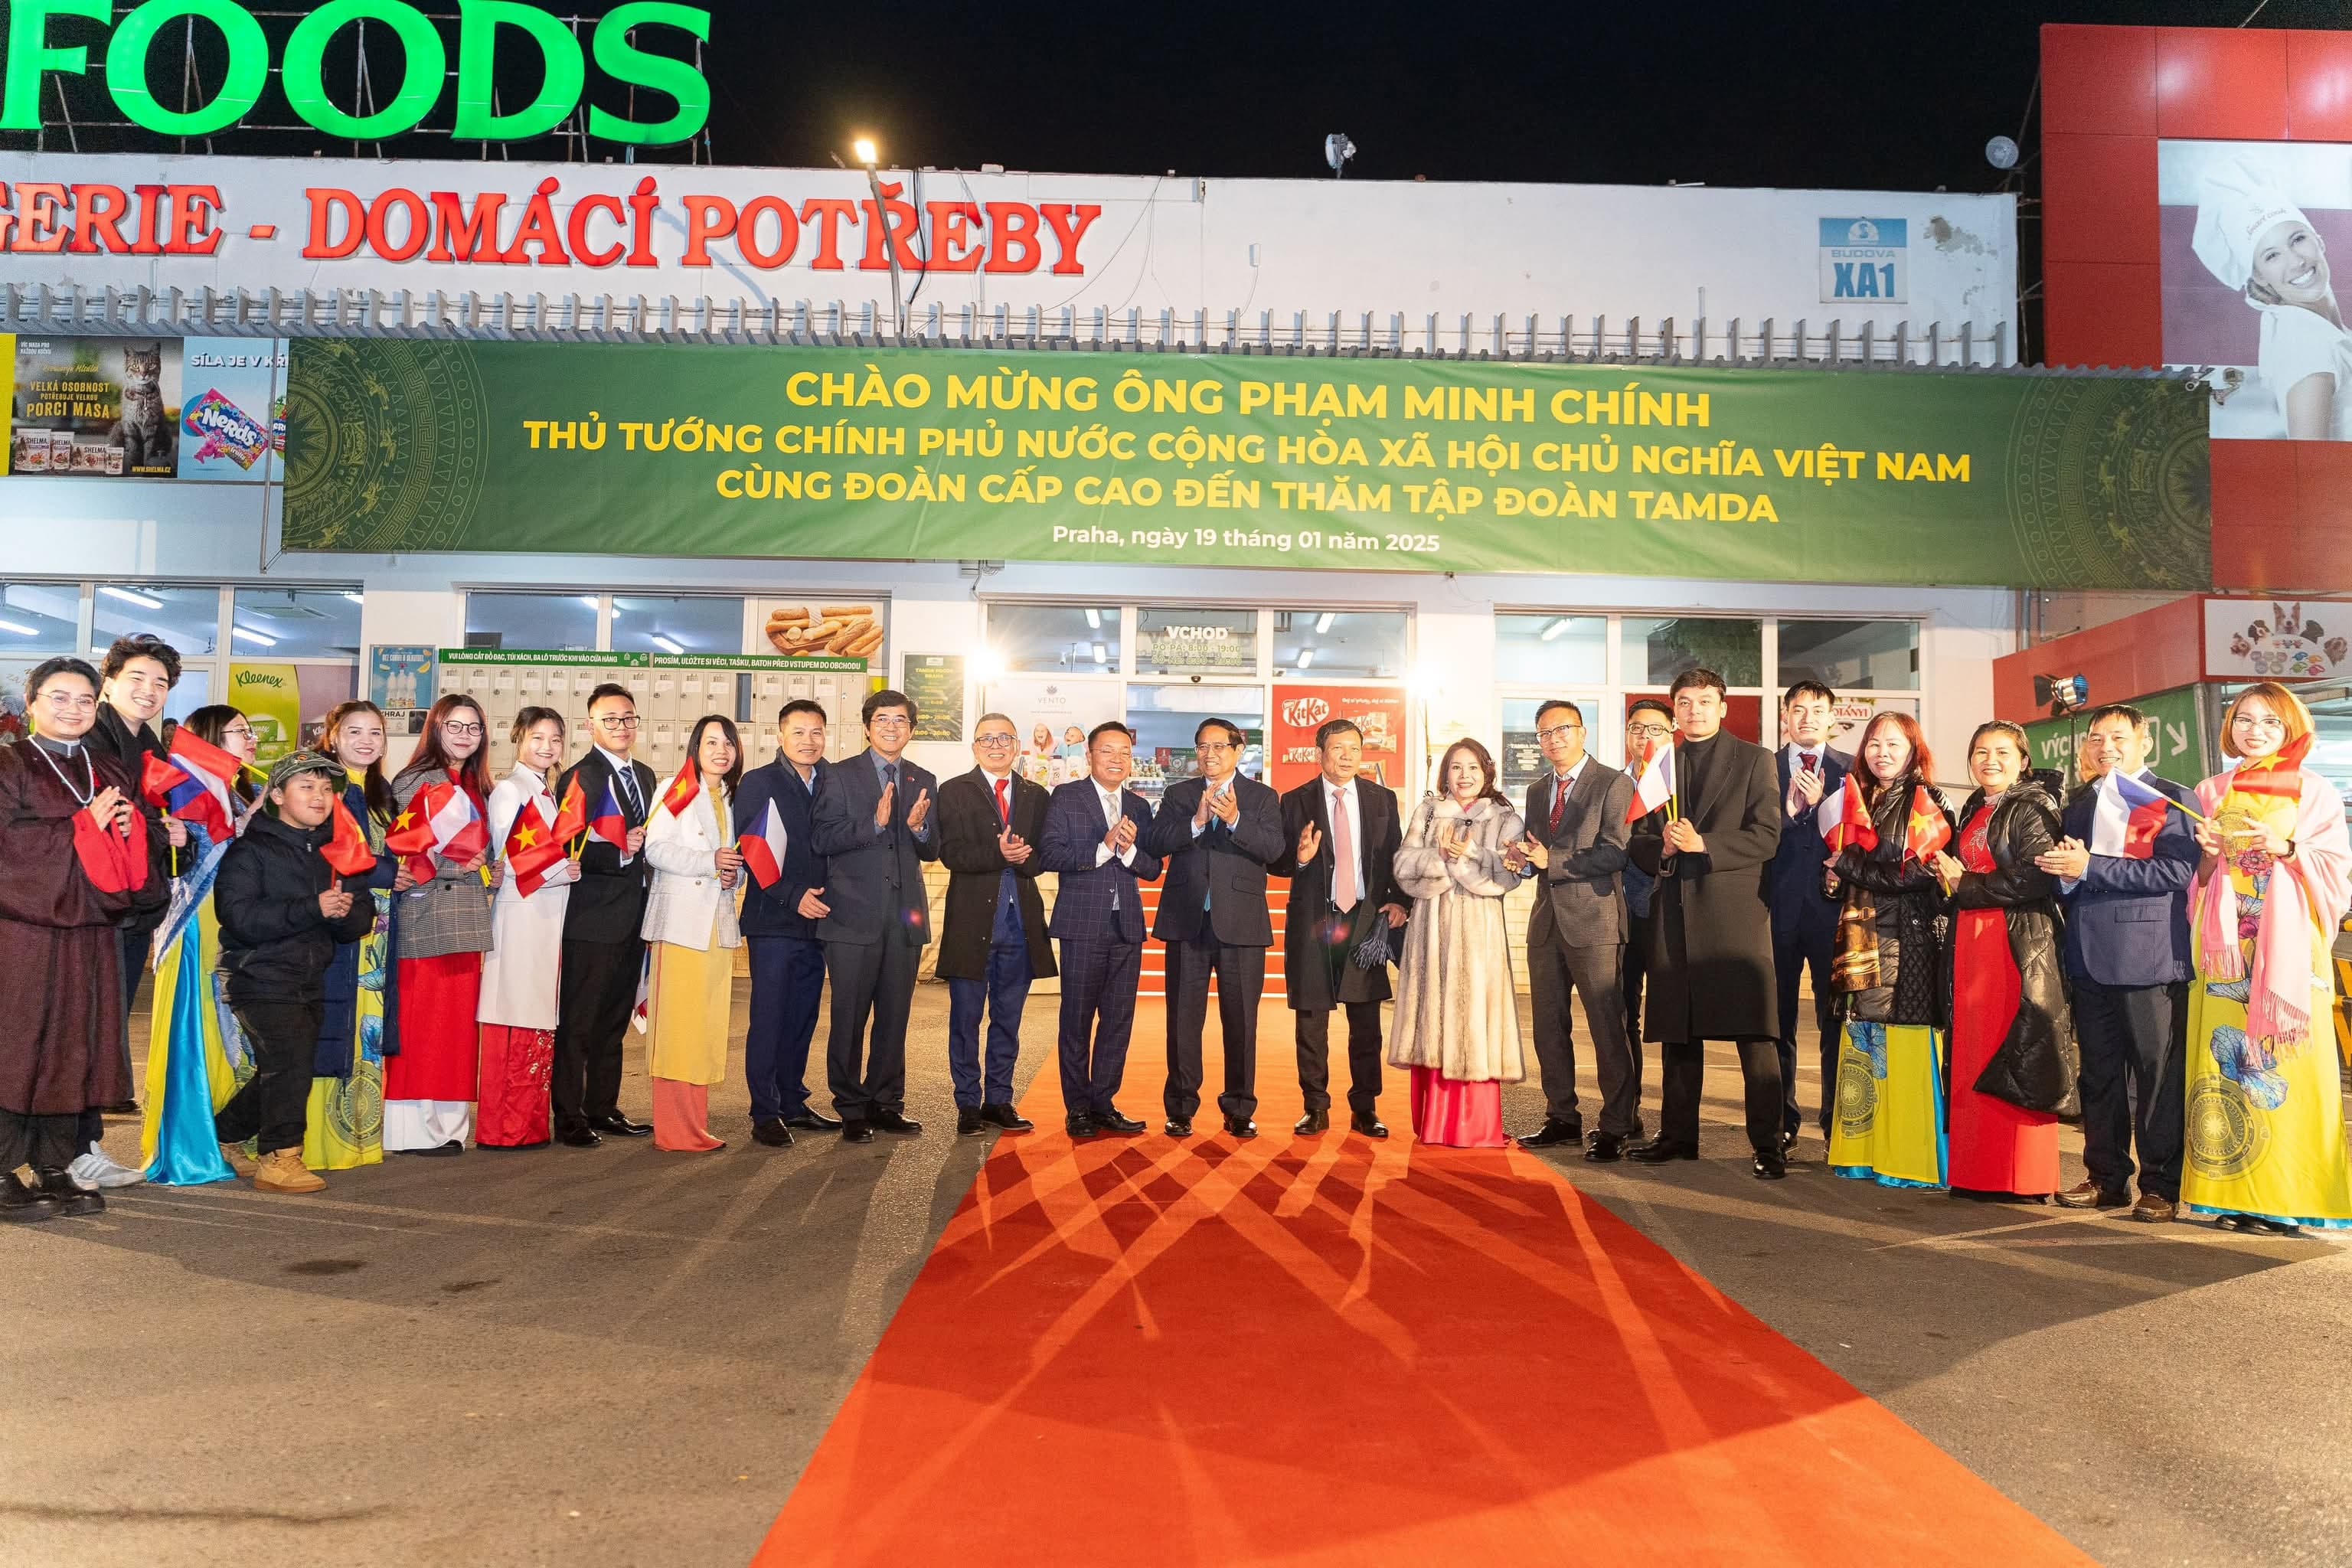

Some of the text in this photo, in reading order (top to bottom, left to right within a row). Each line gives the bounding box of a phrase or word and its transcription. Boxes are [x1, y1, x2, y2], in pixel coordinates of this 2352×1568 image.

[1, 0, 711, 144] FOODS
[0, 181, 224, 254] ERIE
[302, 177, 660, 267] DOMÁCÍ
[681, 182, 1102, 274] POTŘEBY
[1833, 263, 1895, 297] XA1
[191, 353, 226, 367] SÍLA
[229, 355, 247, 368] JE
[249, 355, 261, 368] V
[31, 380, 109, 392] VELKÁ OSOBNOST
[787, 364, 1710, 427] CHÀO MỪNG ÔNG PHẠM MINH CHÍNH
[27, 402, 109, 418] PORCI MASA
[524, 411, 1969, 486] THỦ TƯỚNG CHÍNH PHỦ NƯỚC CỘNG HÒA XÃ HỘI CHỦ NGHĨA VIỆT NAM
[717, 462, 1779, 522] CÙNG ĐOÀN CẤP CAO ĐẾN THĂM TẬP ĐOÀN TAMDA
[1053, 525, 1440, 552] Praha, ngày 19 tháng 01 năm 2025
[1166, 626, 1228, 640] VCHOD
[654, 655, 680, 665] PROSÍM,
[713, 656, 728, 666] VĚCI,
[729, 657, 750, 668] TAŠKU,
[751, 658, 772, 667] BATOH
[773, 658, 789, 668] PŘED
[236, 670, 283, 688] Kleenex
[1289, 698, 1327, 726] KitKat
[1834, 704, 1868, 717] OTÁNYI
